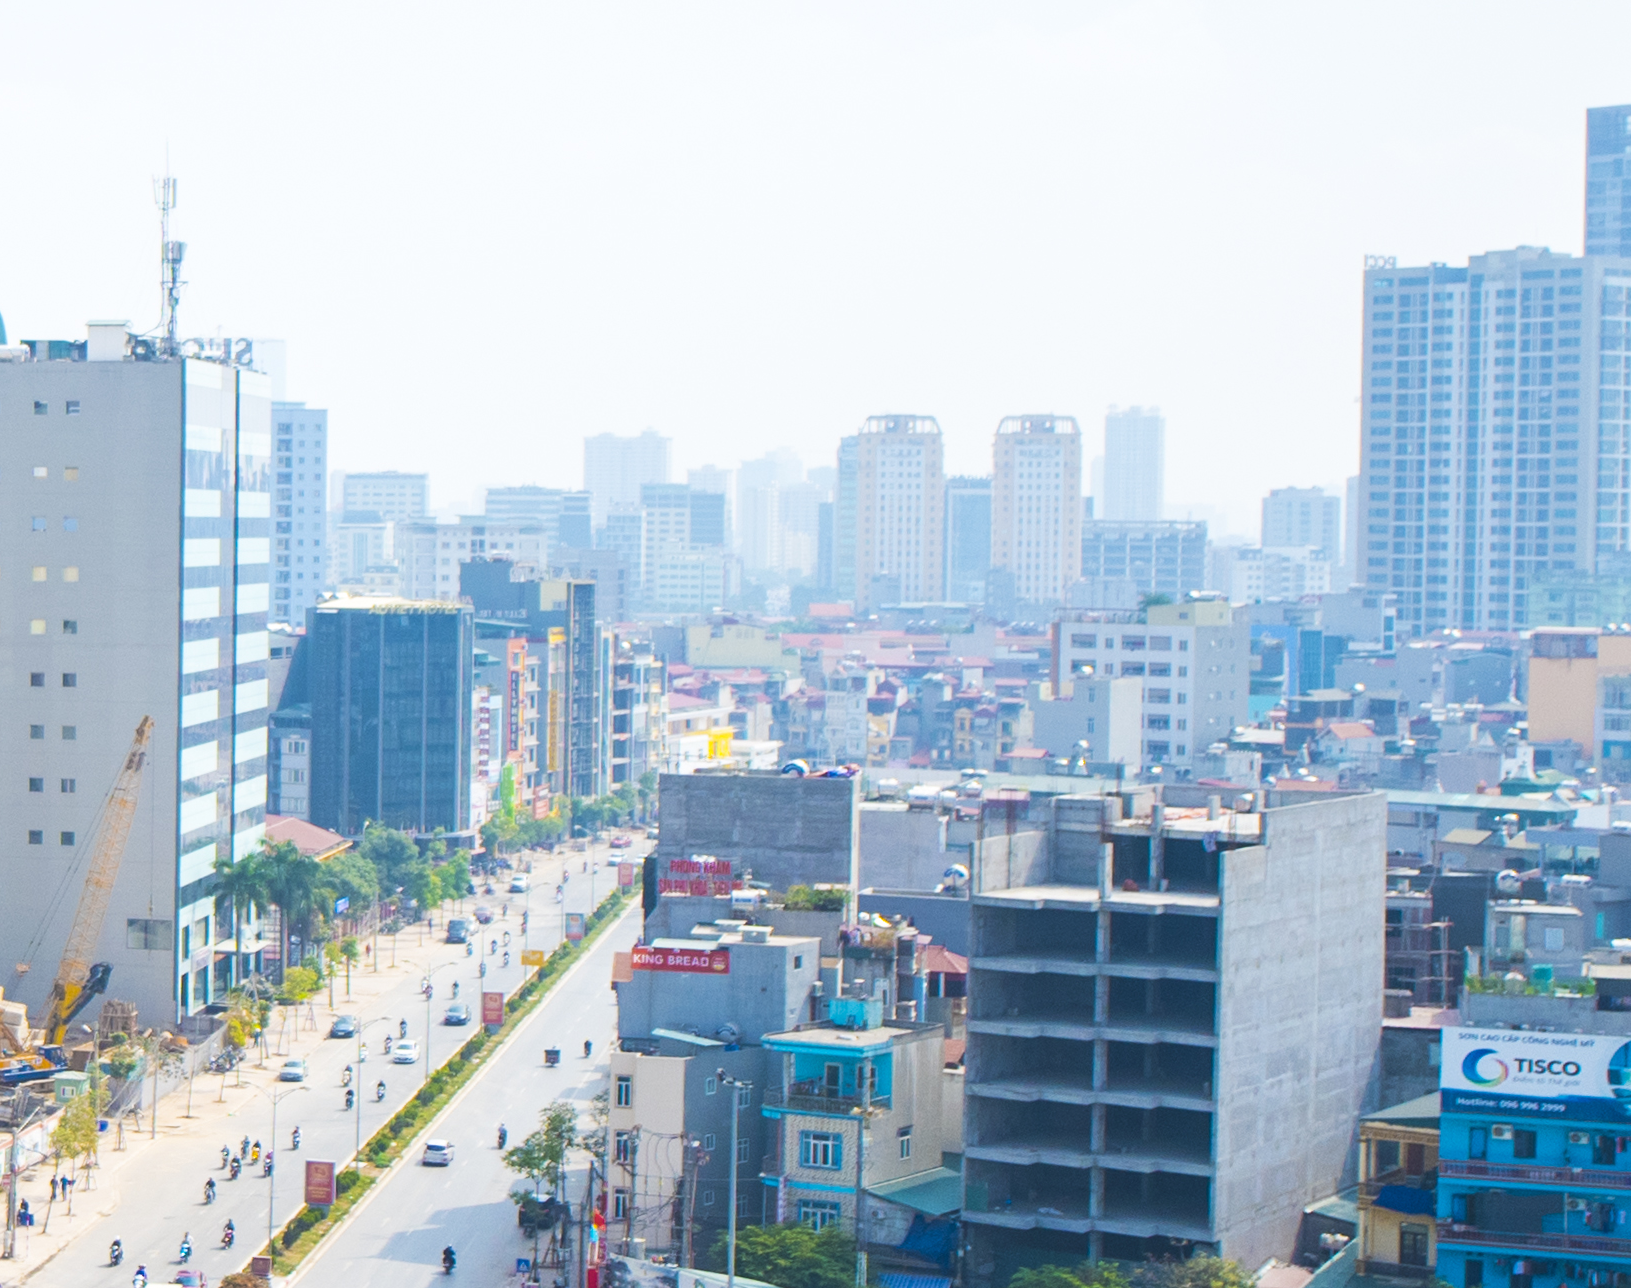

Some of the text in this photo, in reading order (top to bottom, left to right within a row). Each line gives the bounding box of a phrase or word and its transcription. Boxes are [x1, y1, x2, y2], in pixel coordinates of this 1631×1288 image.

[633, 954, 709, 967] KING BREAD
[1514, 1058, 1581, 1076] TISCO
